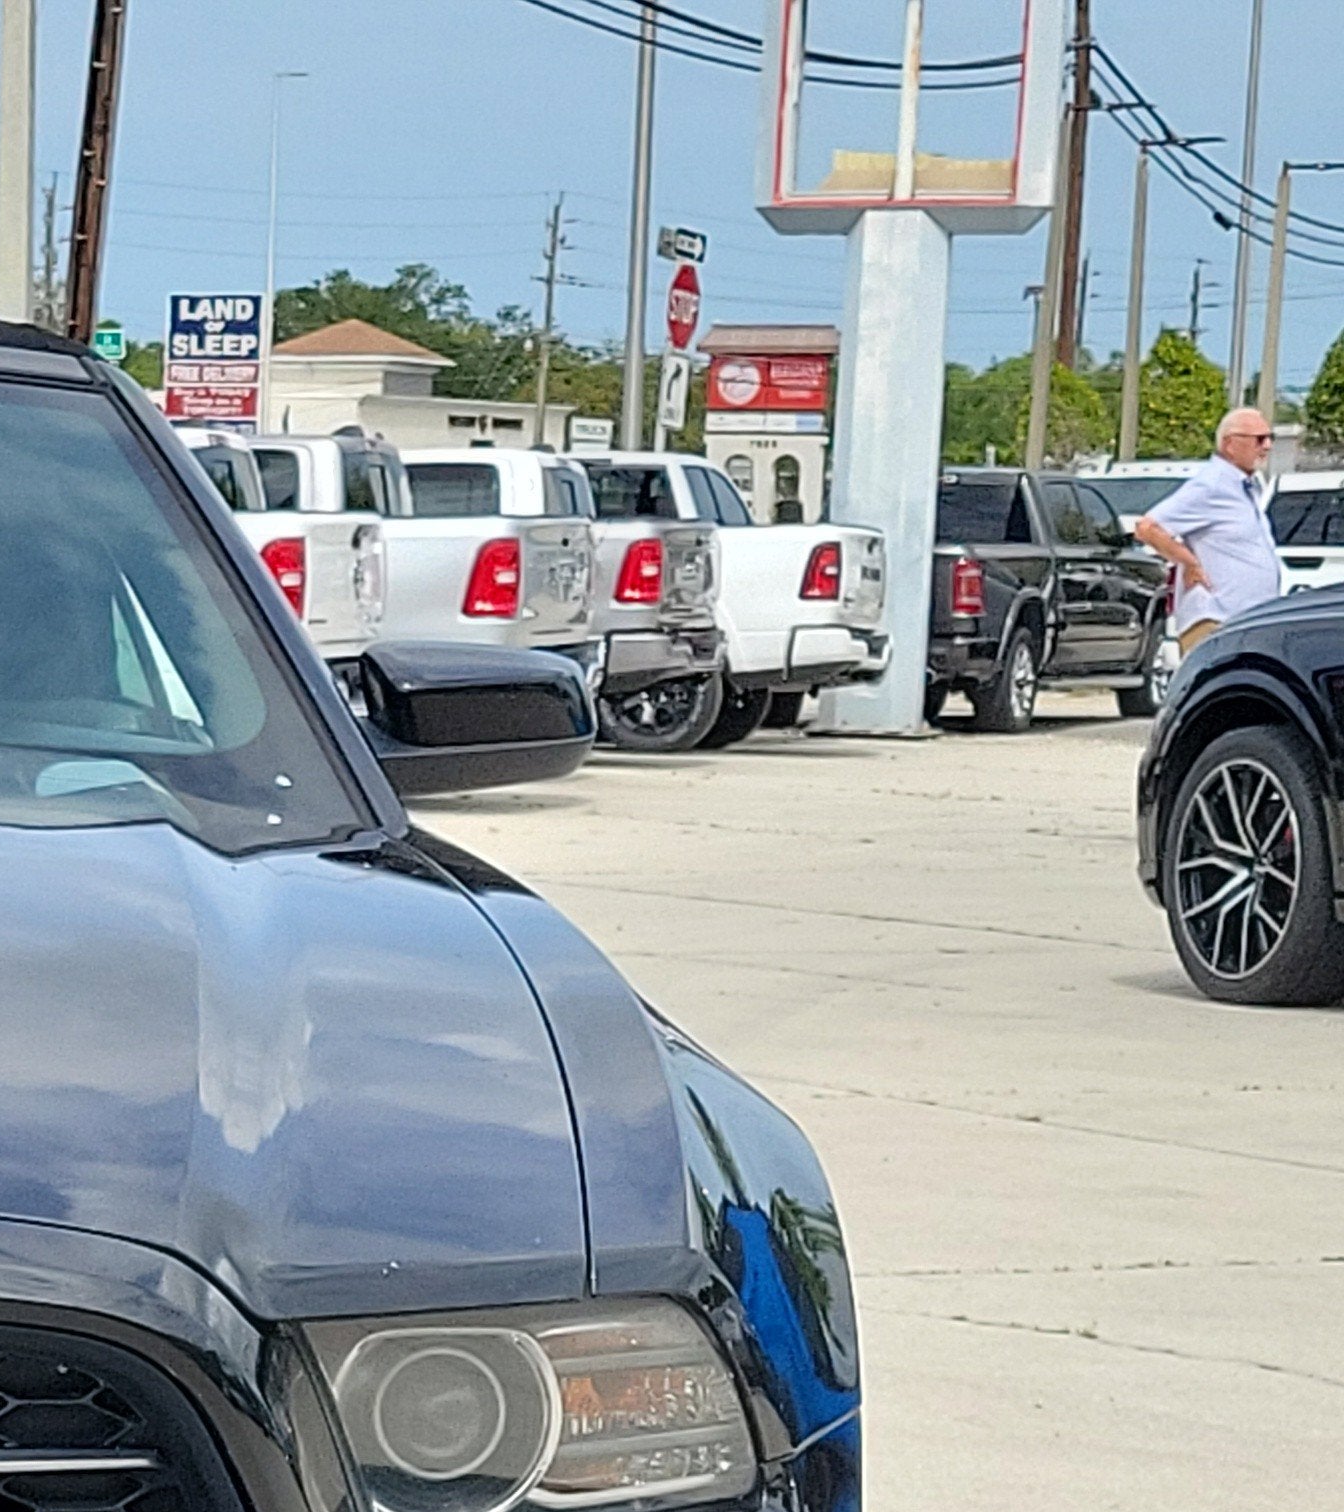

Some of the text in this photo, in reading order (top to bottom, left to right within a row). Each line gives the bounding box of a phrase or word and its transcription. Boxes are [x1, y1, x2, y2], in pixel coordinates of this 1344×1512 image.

[178, 298, 255, 321] LAND
[669, 288, 699, 323] STOP
[203, 321, 226, 332] OF
[172, 333, 258, 356] SLEEP
